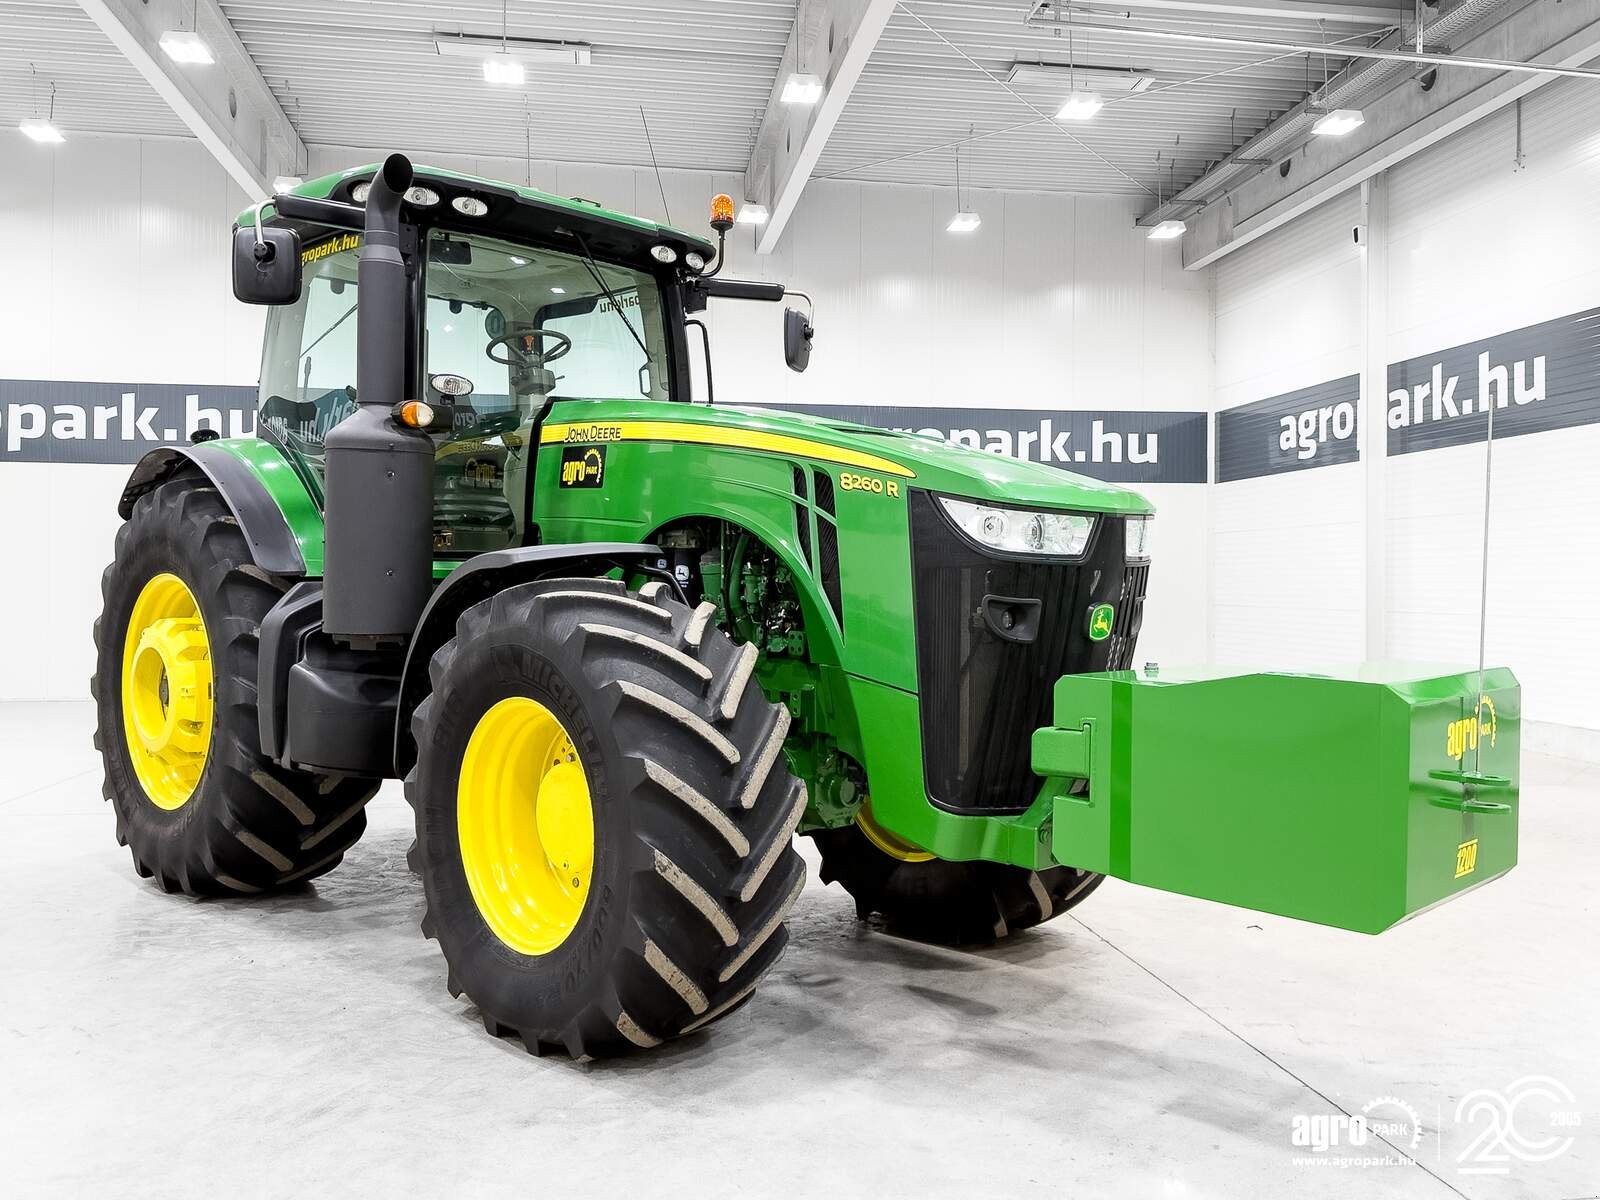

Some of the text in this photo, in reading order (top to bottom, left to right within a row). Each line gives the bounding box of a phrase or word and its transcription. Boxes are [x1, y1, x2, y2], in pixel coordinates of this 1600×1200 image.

[0, 392, 258, 452] park.hu
[564, 425, 622, 441] JOHN DEERE
[880, 419, 1158, 464] ark.hu
[562, 461, 586, 485] agro
[840, 472, 900, 499] 8260 R
[1447, 717, 1477, 761] agro
[1456, 843, 1477, 875] 1200
